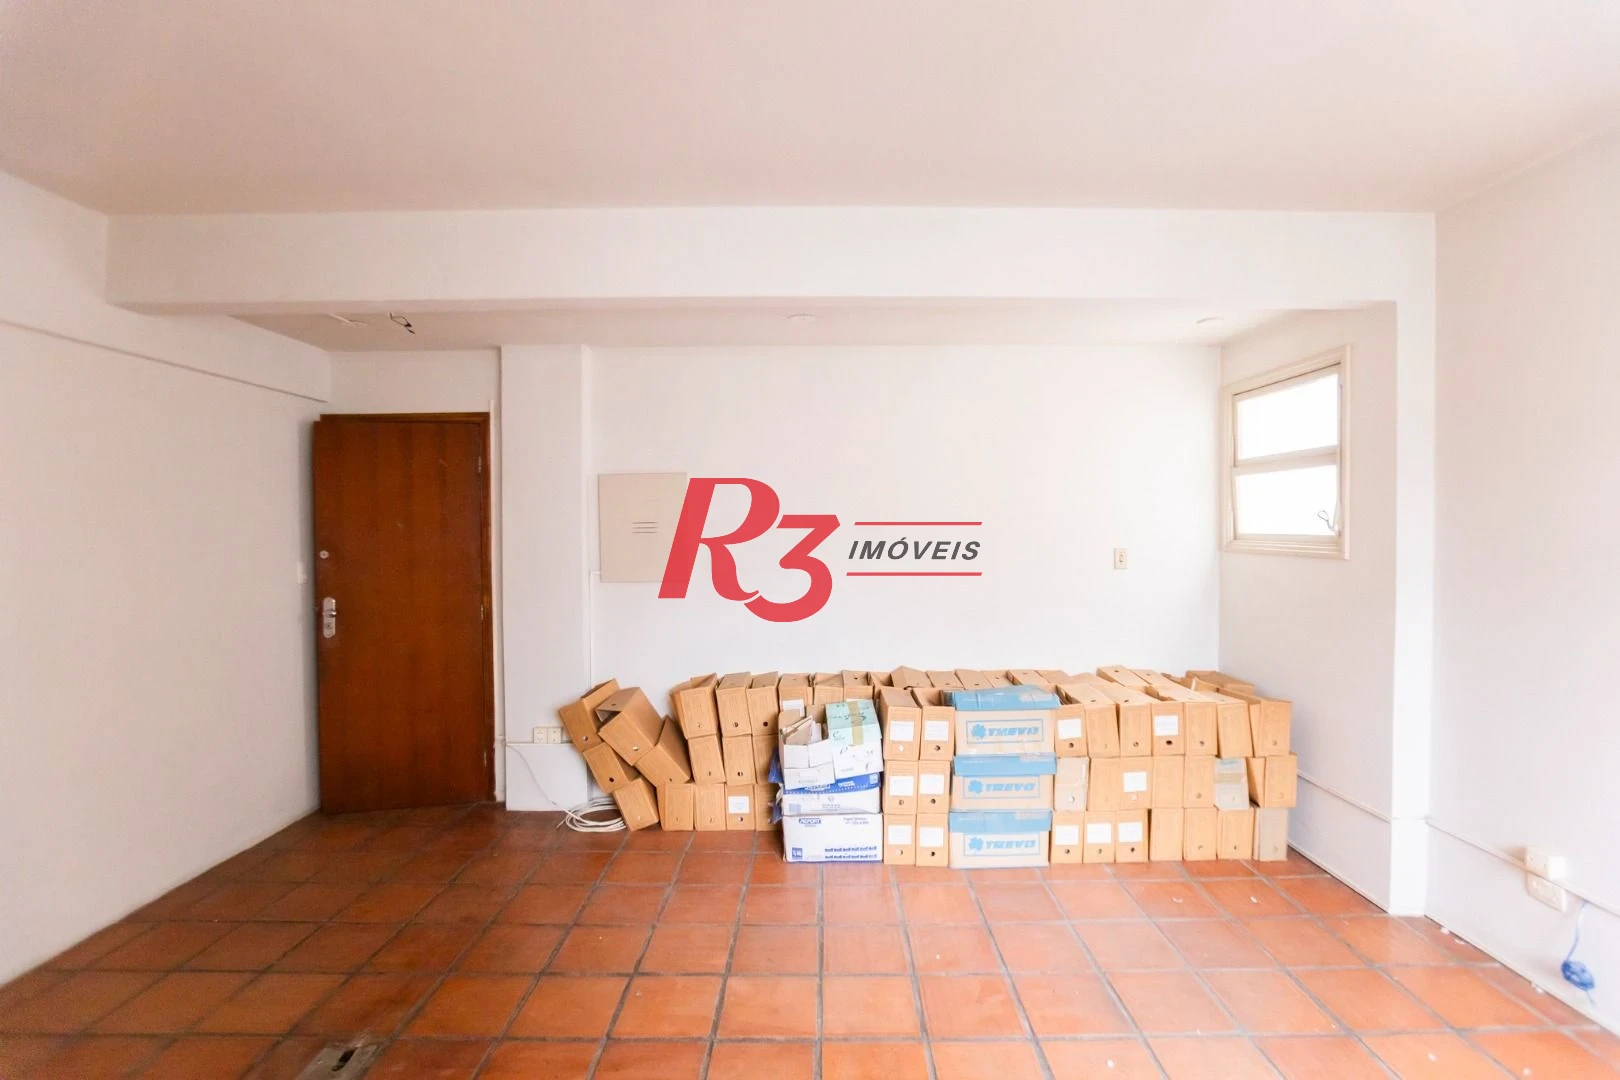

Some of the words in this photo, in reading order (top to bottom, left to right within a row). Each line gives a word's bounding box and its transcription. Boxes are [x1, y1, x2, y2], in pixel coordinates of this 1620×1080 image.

[988, 726, 1040, 736] TREVO
[985, 783, 1036, 792] TREVO
[985, 839, 1036, 849] TREVO
